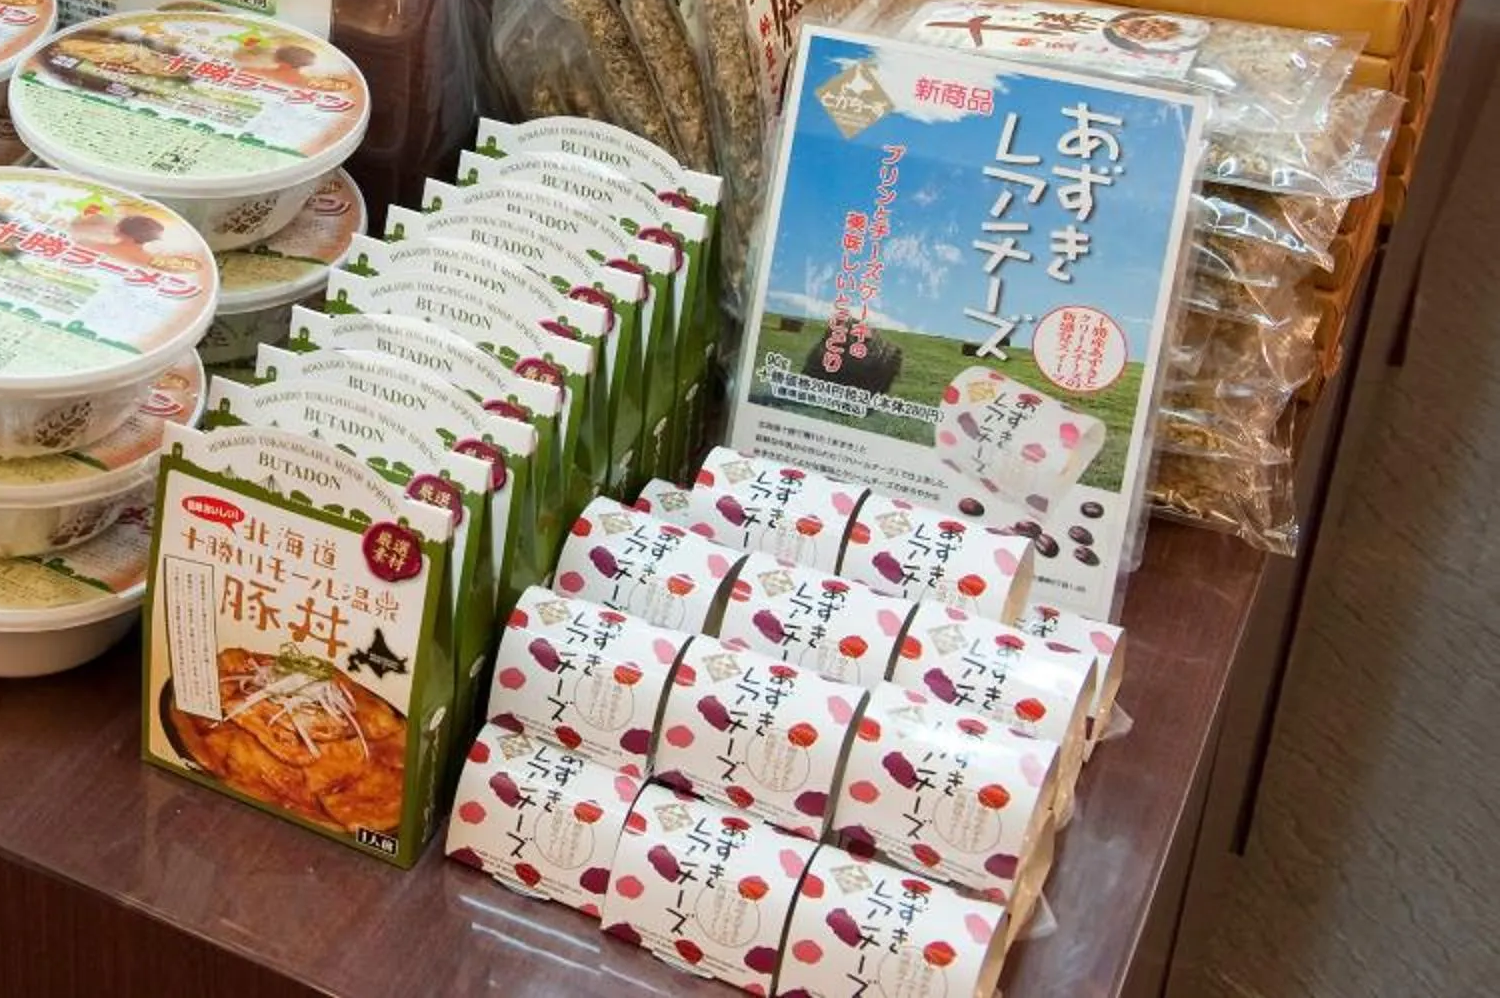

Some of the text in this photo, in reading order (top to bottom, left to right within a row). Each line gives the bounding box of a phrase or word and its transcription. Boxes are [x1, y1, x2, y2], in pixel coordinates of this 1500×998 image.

[166, 53, 356, 112] 十勝ラーメン
[915, 74, 994, 116] 新商品
[561, 140, 632, 169] BUTADON
[541, 174, 614, 204] BUTADON
[1050, 102, 1125, 283] あずき
[471, 229, 544, 260] BUTADON
[507, 204, 579, 234] BUTADON
[962, 112, 1046, 361] レアチーズ
[433, 262, 507, 295] BUTADON
[417, 297, 492, 330] BUTADON
[377, 338, 453, 372] BUTADON
[349, 376, 426, 411] BUTADON
[304, 407, 385, 443] BUTADON
[259, 452, 342, 491] BUTADON
[741, 471, 774, 549] レアチー
[766, 475, 805, 529] あずき
[244, 517, 338, 570] 北海道
[640, 533, 686, 584] あずき
[900, 523, 931, 599] レアチー
[929, 529, 963, 588] あずき
[182, 527, 398, 623] 十勝川モール温泉
[220, 574, 349, 658] 豚丼
[782, 583, 814, 662] レアチー
[809, 589, 847, 649] あずき
[548, 611, 590, 722] レアチーズ
[584, 621, 624, 677] あずき
[955, 638, 986, 706] レアチ
[717, 667, 761, 781] レアチーズ
[755, 674, 796, 737] あずき
[507, 746, 552, 859] レアチーズ
[544, 756, 584, 813] あずき
[666, 818, 712, 934] レアチーズ
[706, 825, 748, 889] あずき
[889, 889, 930, 954] あずき
